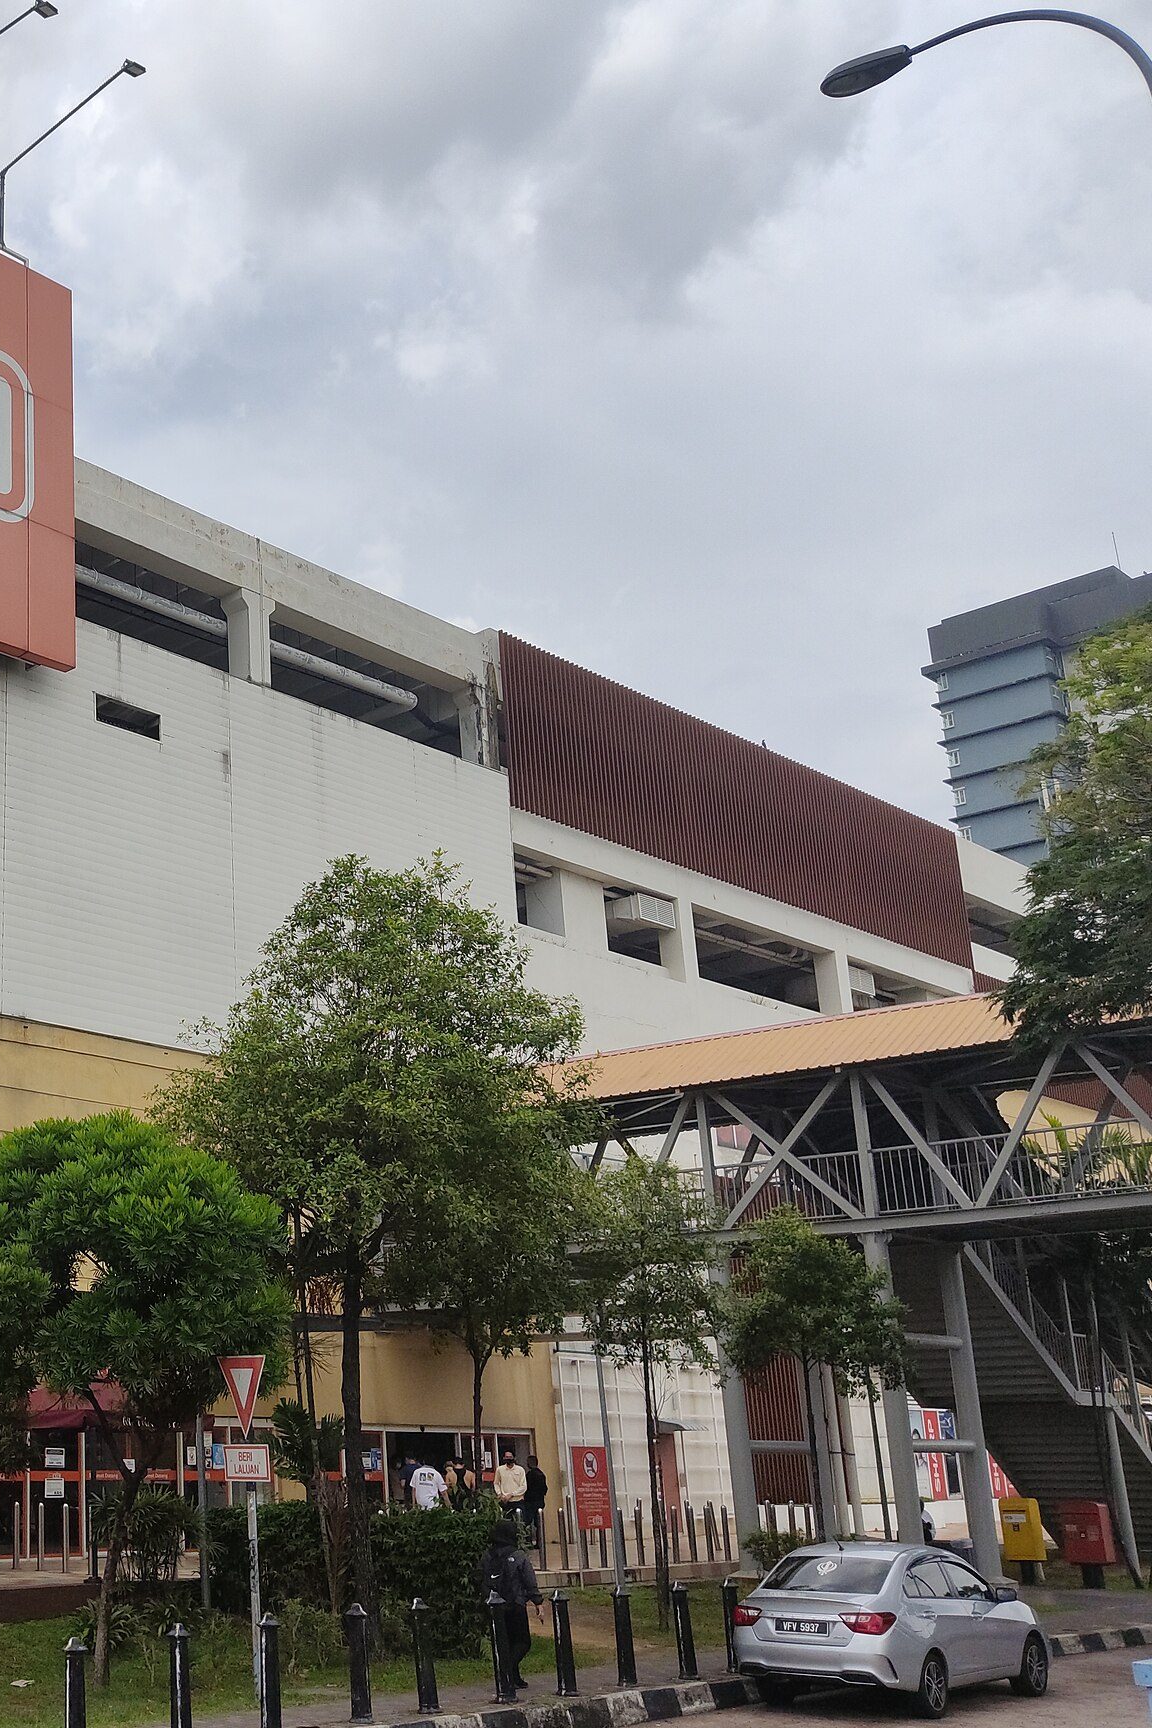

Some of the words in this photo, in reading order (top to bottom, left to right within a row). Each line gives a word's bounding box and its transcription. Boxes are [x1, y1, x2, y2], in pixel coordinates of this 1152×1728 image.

[238, 1451, 253, 1462] BERI
[234, 1463, 260, 1475] LALUAN
[782, 1621, 797, 1632] VFV
[799, 1622, 820, 1633] 5937
